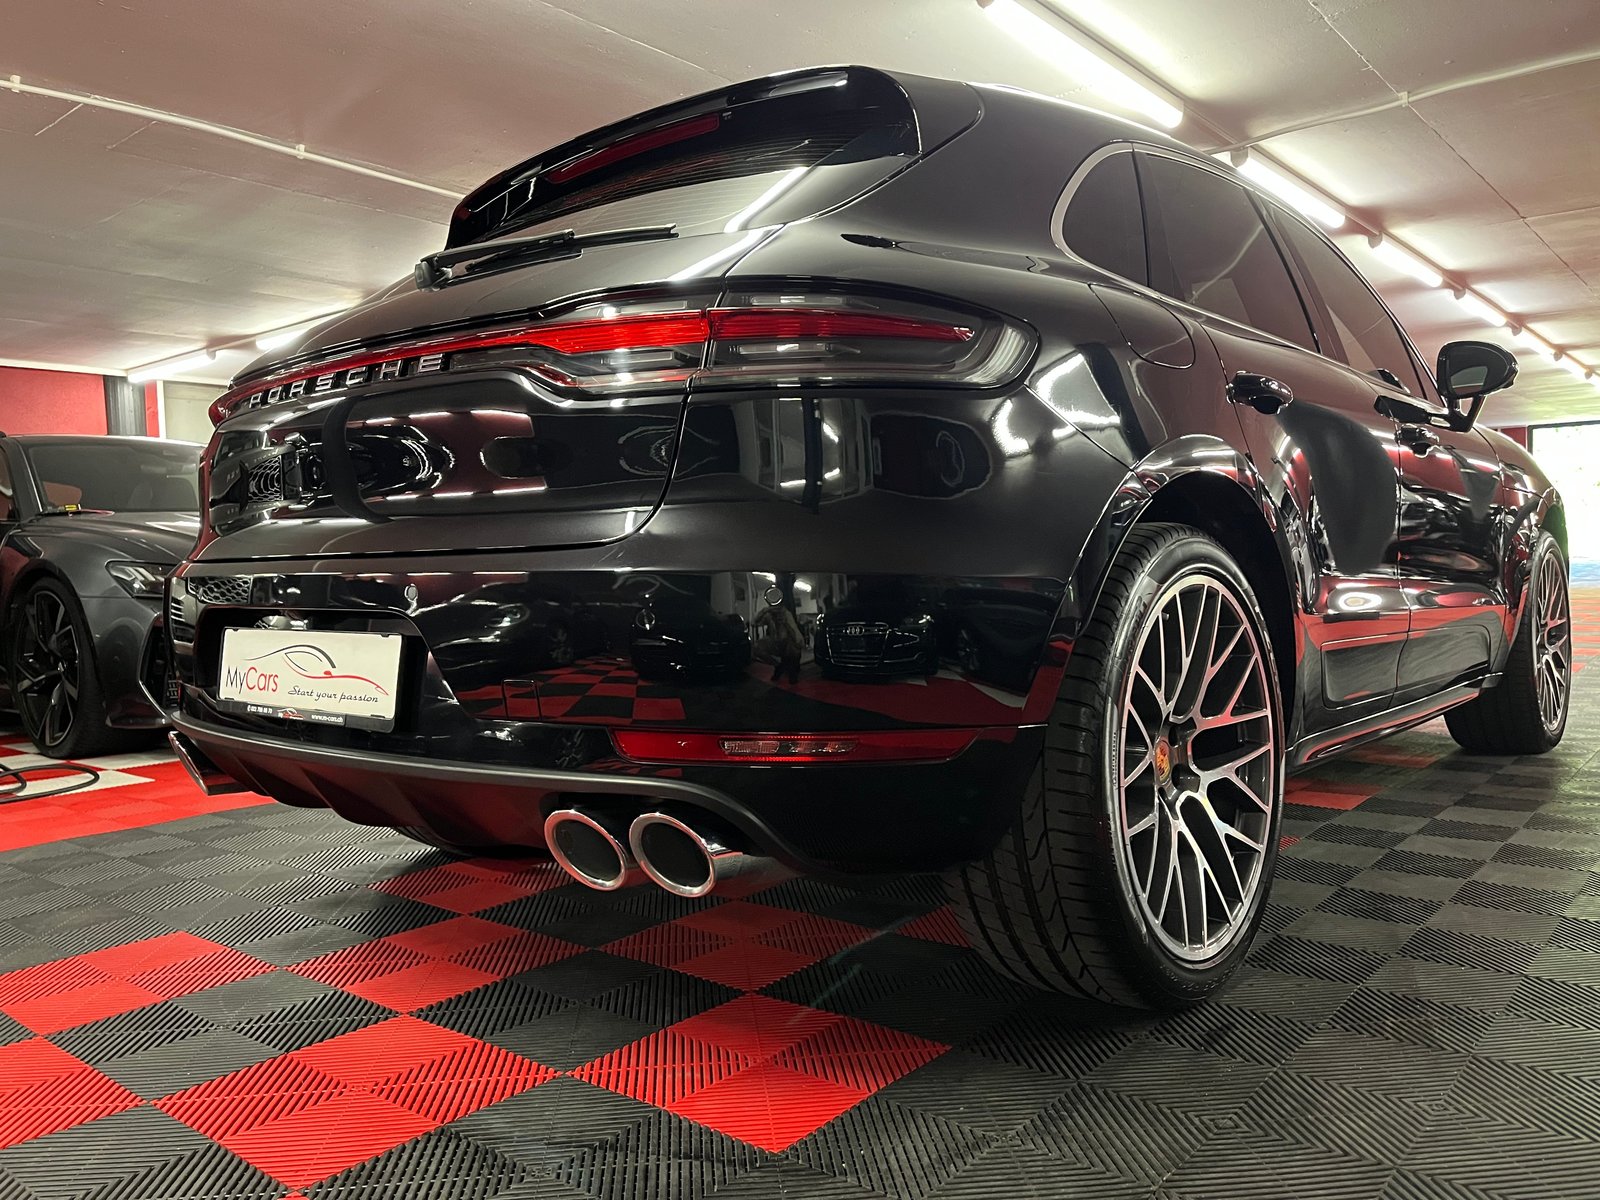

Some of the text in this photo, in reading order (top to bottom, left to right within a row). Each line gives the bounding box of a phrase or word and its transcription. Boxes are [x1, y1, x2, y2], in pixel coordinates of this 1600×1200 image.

[249, 353, 444, 408] PORSCHE
[225, 666, 279, 694] MyCars
[287, 684, 379, 703] Start your passion
